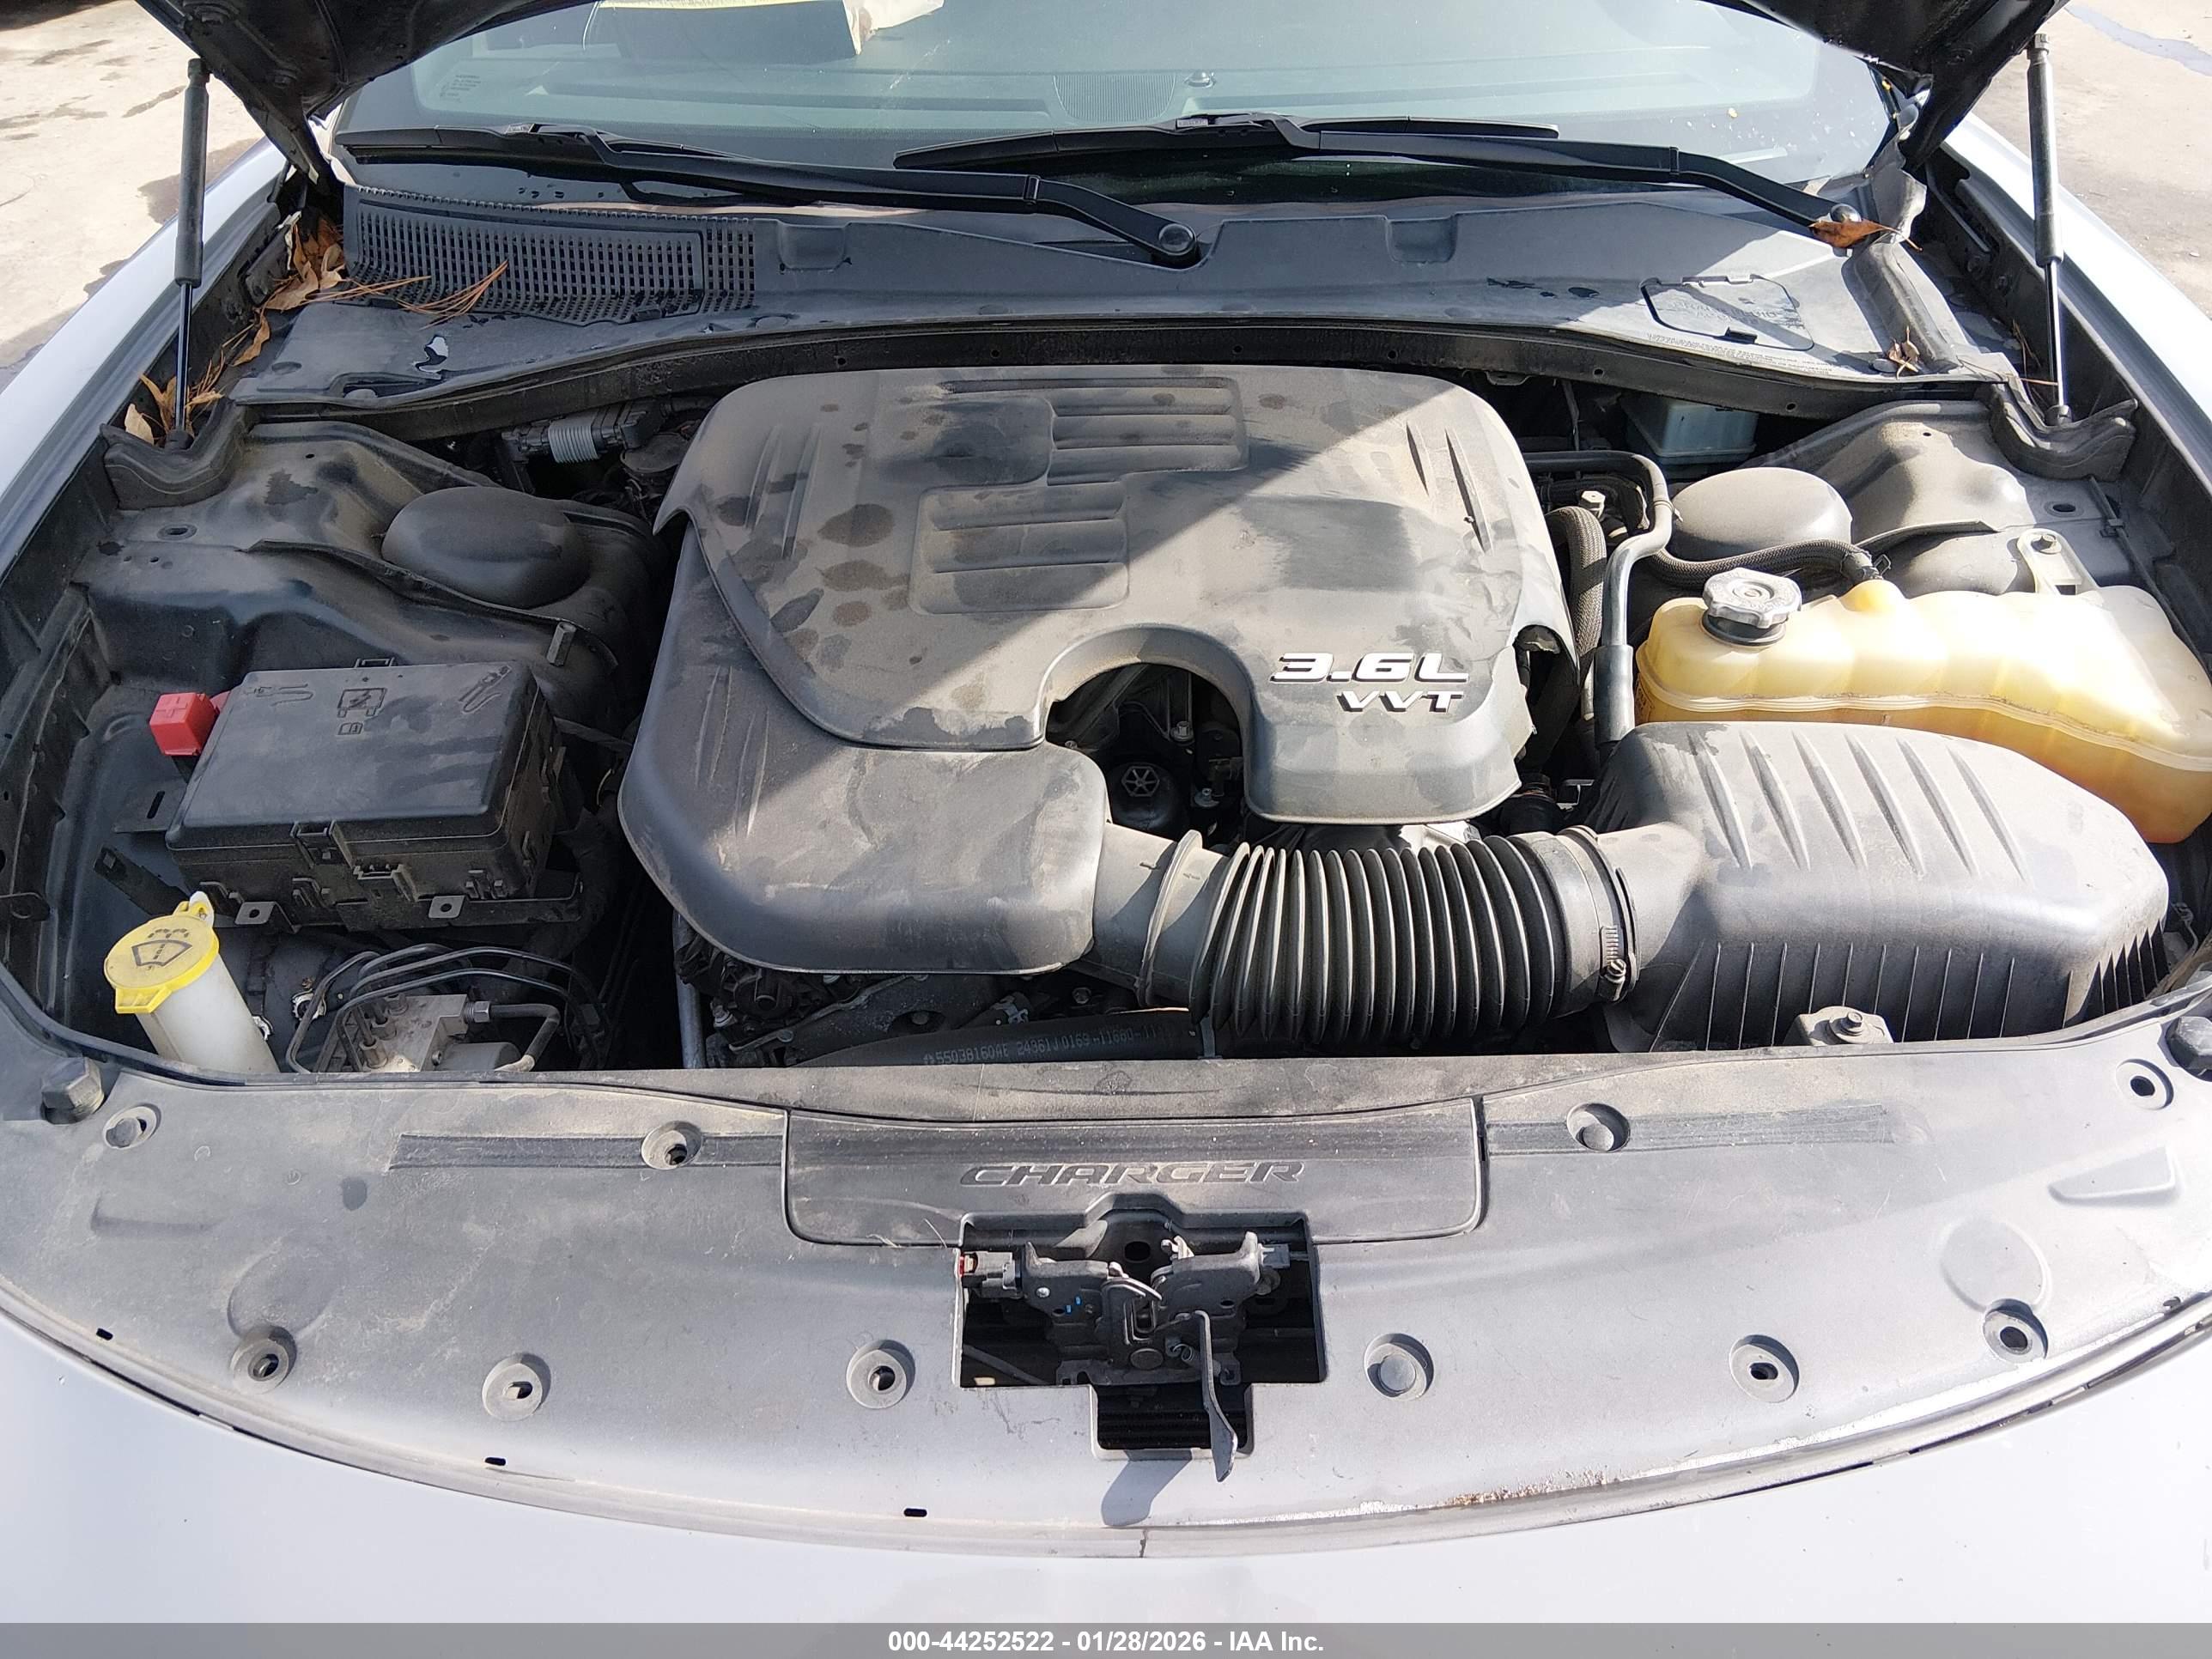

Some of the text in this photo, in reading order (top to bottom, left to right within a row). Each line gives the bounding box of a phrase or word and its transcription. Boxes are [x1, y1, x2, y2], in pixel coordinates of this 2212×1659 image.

[1270, 652, 1469, 684] 3.6L
[1335, 690, 1464, 713] VVT
[959, 1161, 1305, 1186] CHARGER
